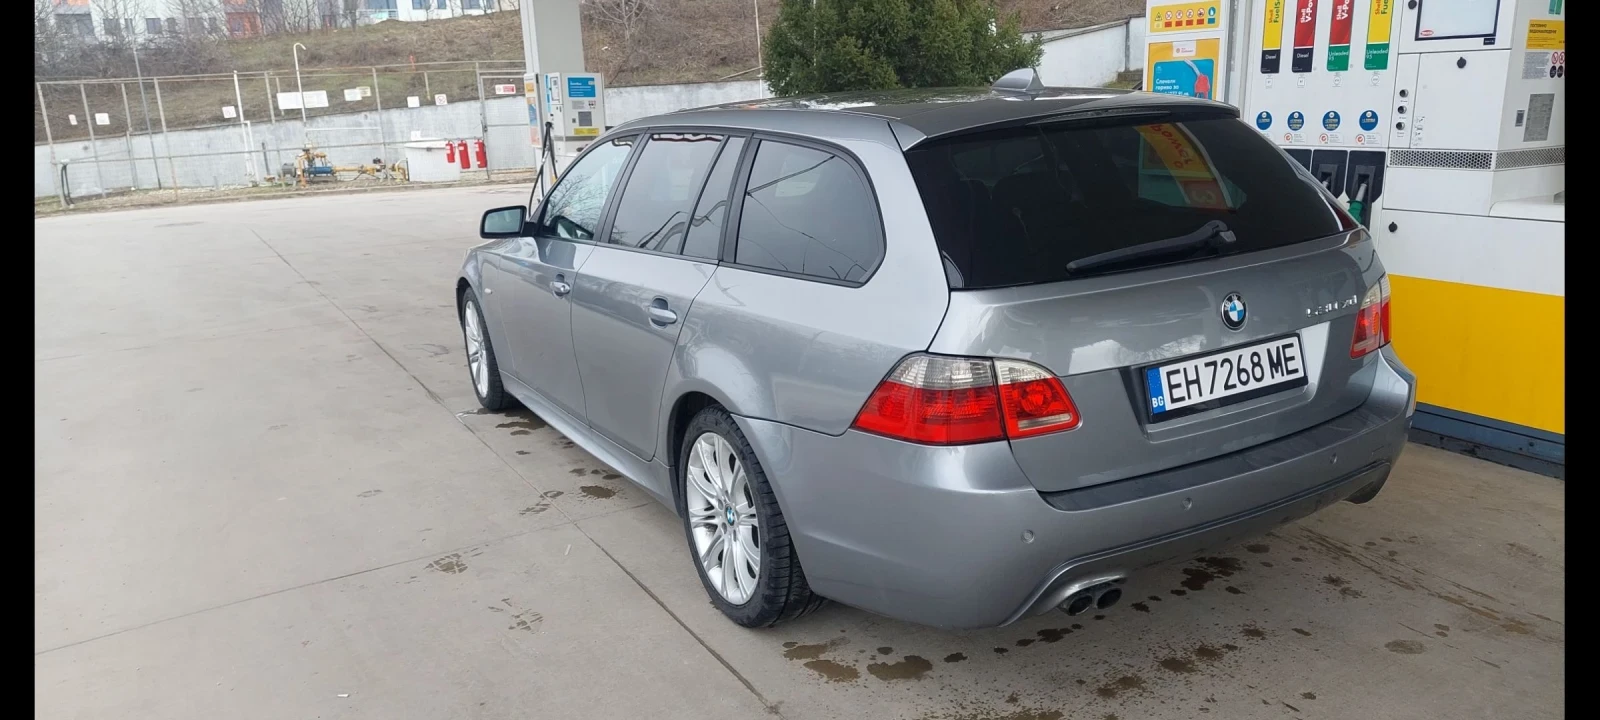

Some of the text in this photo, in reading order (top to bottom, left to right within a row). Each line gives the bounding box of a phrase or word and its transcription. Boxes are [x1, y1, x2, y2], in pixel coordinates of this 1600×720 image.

[1273, 0, 1281, 23] FuelS
[1165, 342, 1300, 405] EH 7268 ME
[1152, 395, 1164, 408] BG
